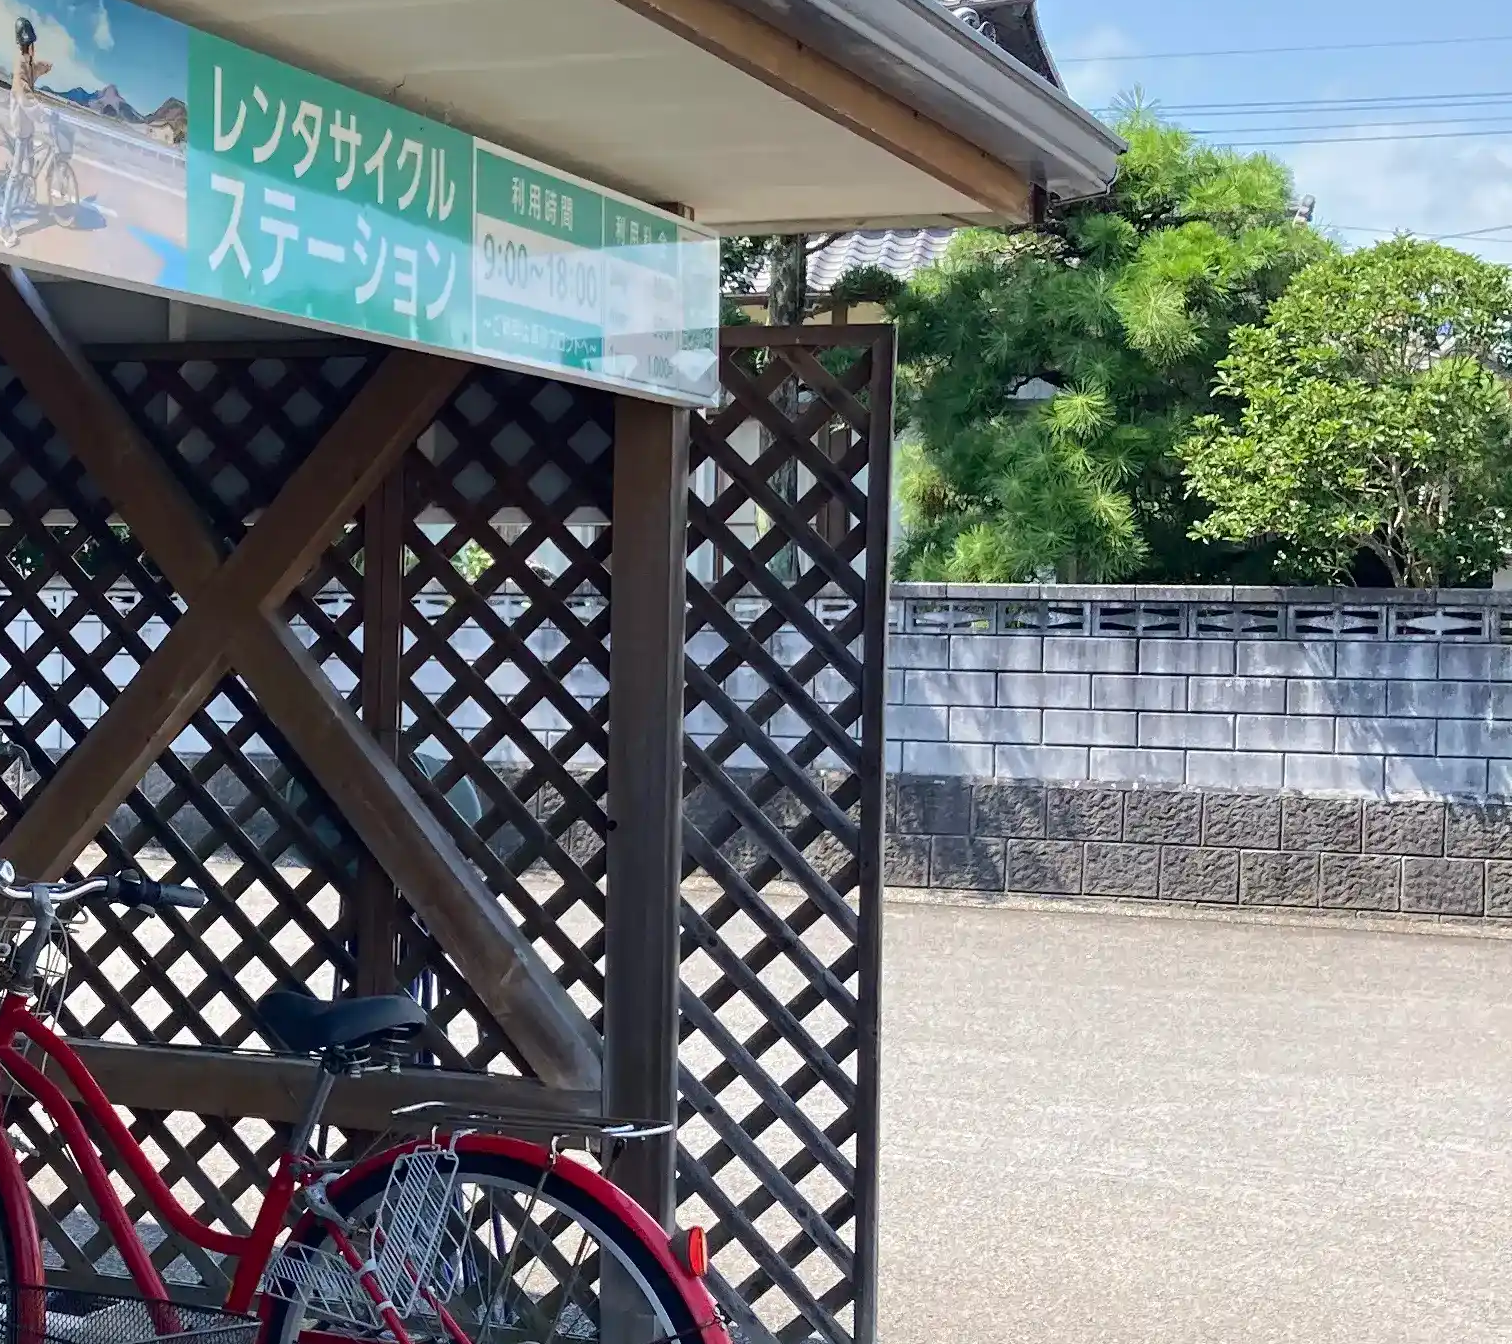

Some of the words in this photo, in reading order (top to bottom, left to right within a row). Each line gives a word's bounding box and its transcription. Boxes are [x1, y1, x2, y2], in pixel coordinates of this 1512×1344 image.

[211, 64, 456, 223] レンタサイクル
[511, 176, 574, 232] 利用時間
[208, 171, 457, 323] ステーション
